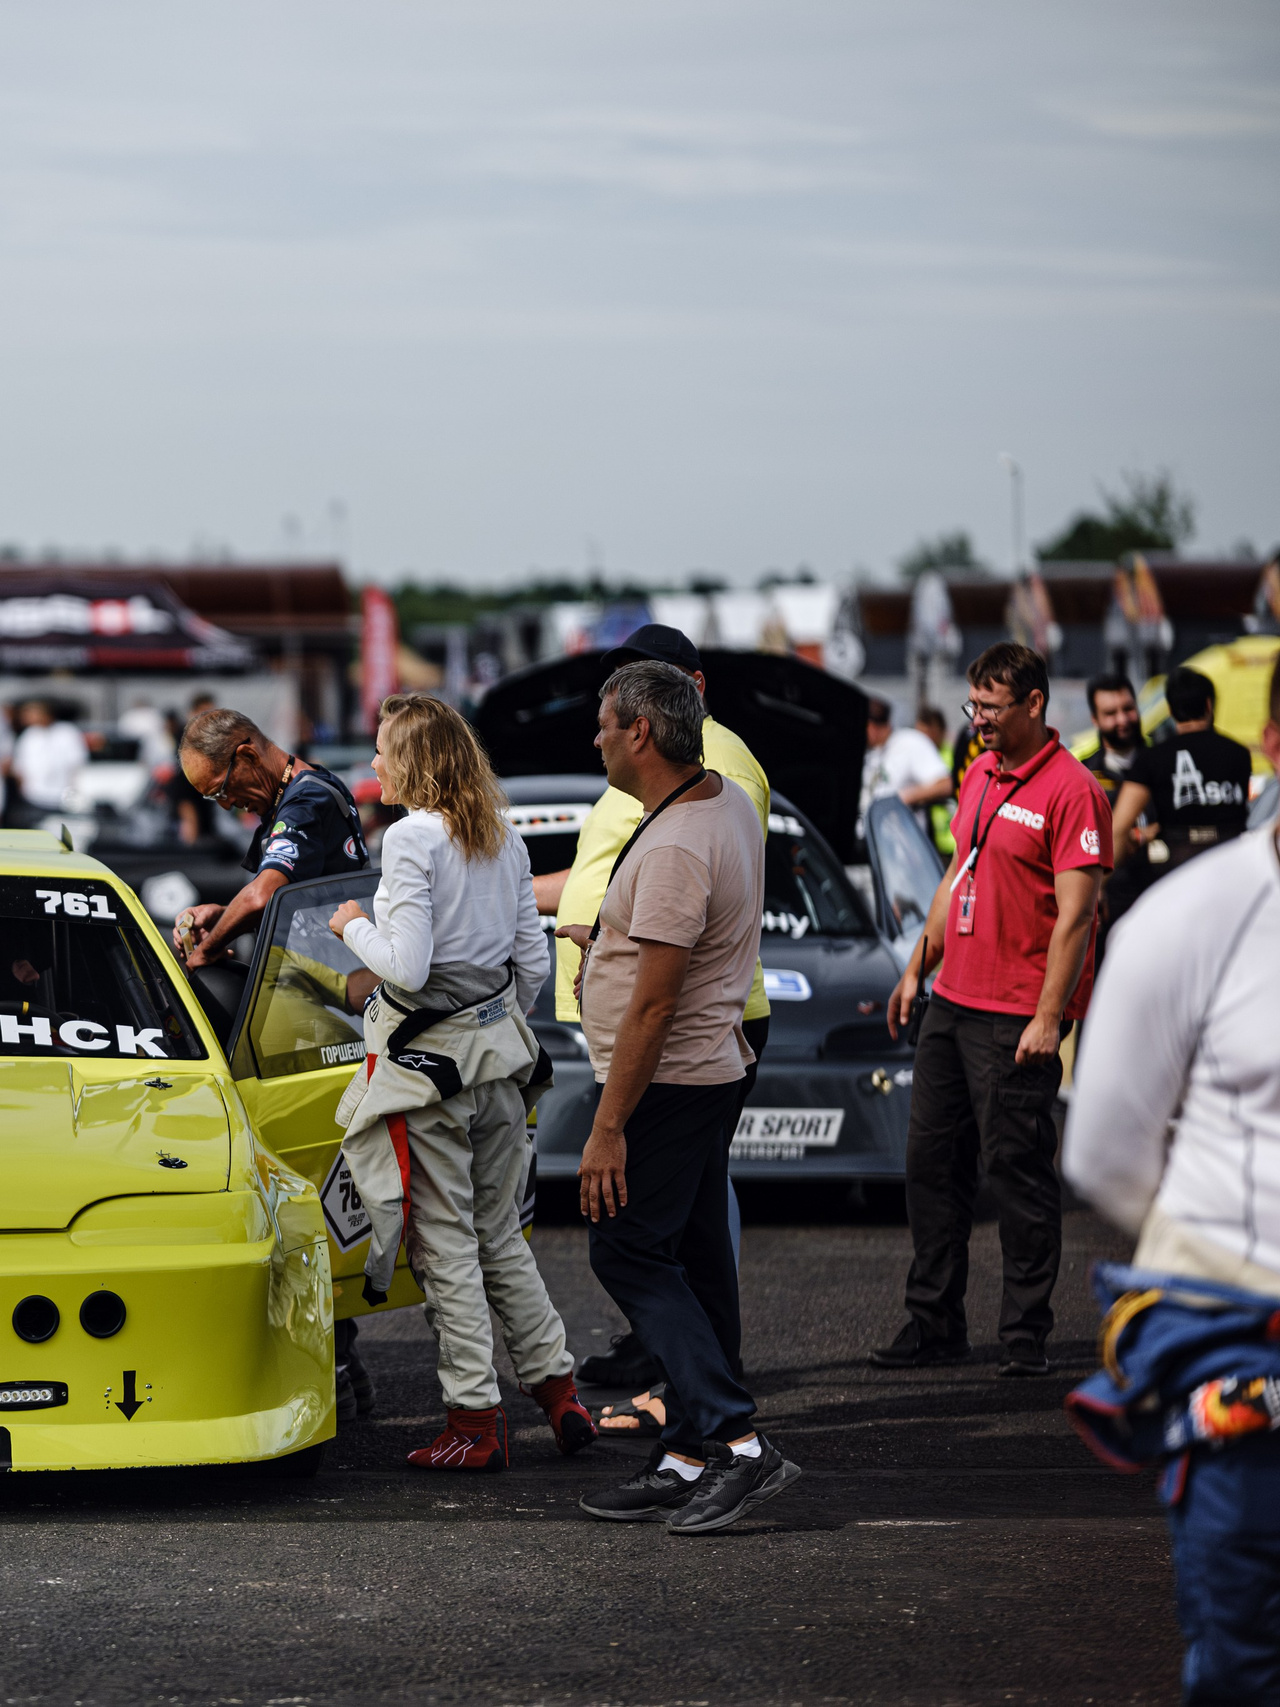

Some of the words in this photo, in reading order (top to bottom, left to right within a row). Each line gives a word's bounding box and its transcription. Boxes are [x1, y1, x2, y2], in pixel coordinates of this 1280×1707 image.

[35, 889, 117, 920] 761
[760, 1113, 837, 1138] SPORT
[339, 1181, 365, 1213] 76
[349, 1219, 364, 1228] FEST
